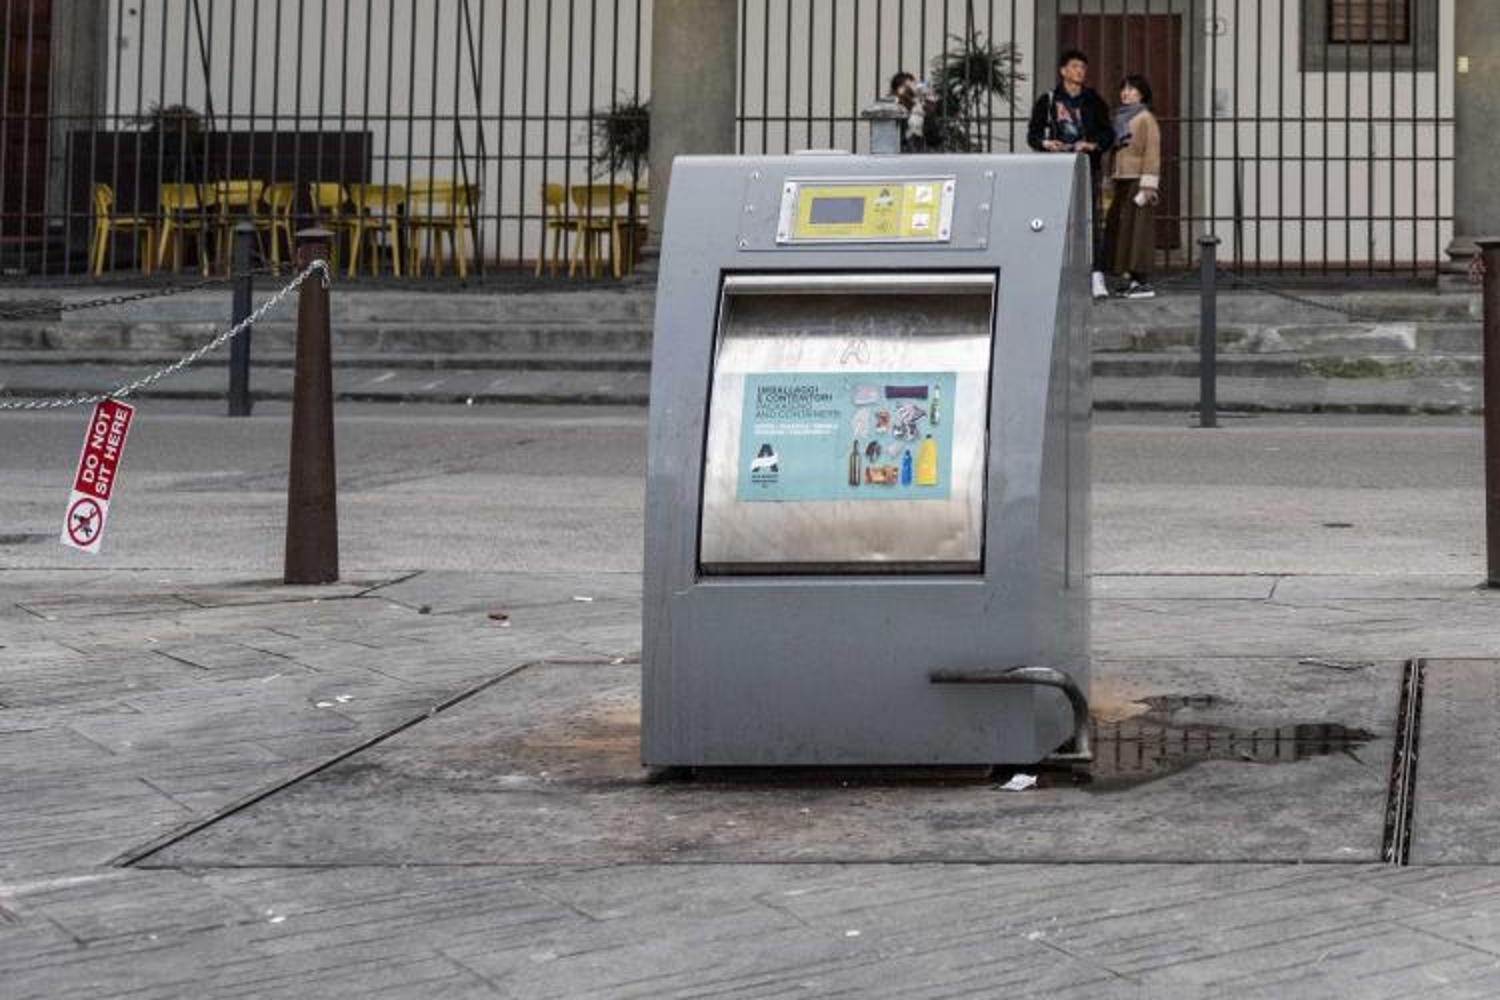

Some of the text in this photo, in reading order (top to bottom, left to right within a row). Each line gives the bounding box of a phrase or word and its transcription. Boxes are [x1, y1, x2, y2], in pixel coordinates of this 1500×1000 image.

[82, 409, 112, 483] DO NOT
[95, 408, 129, 495] SIT HERE
